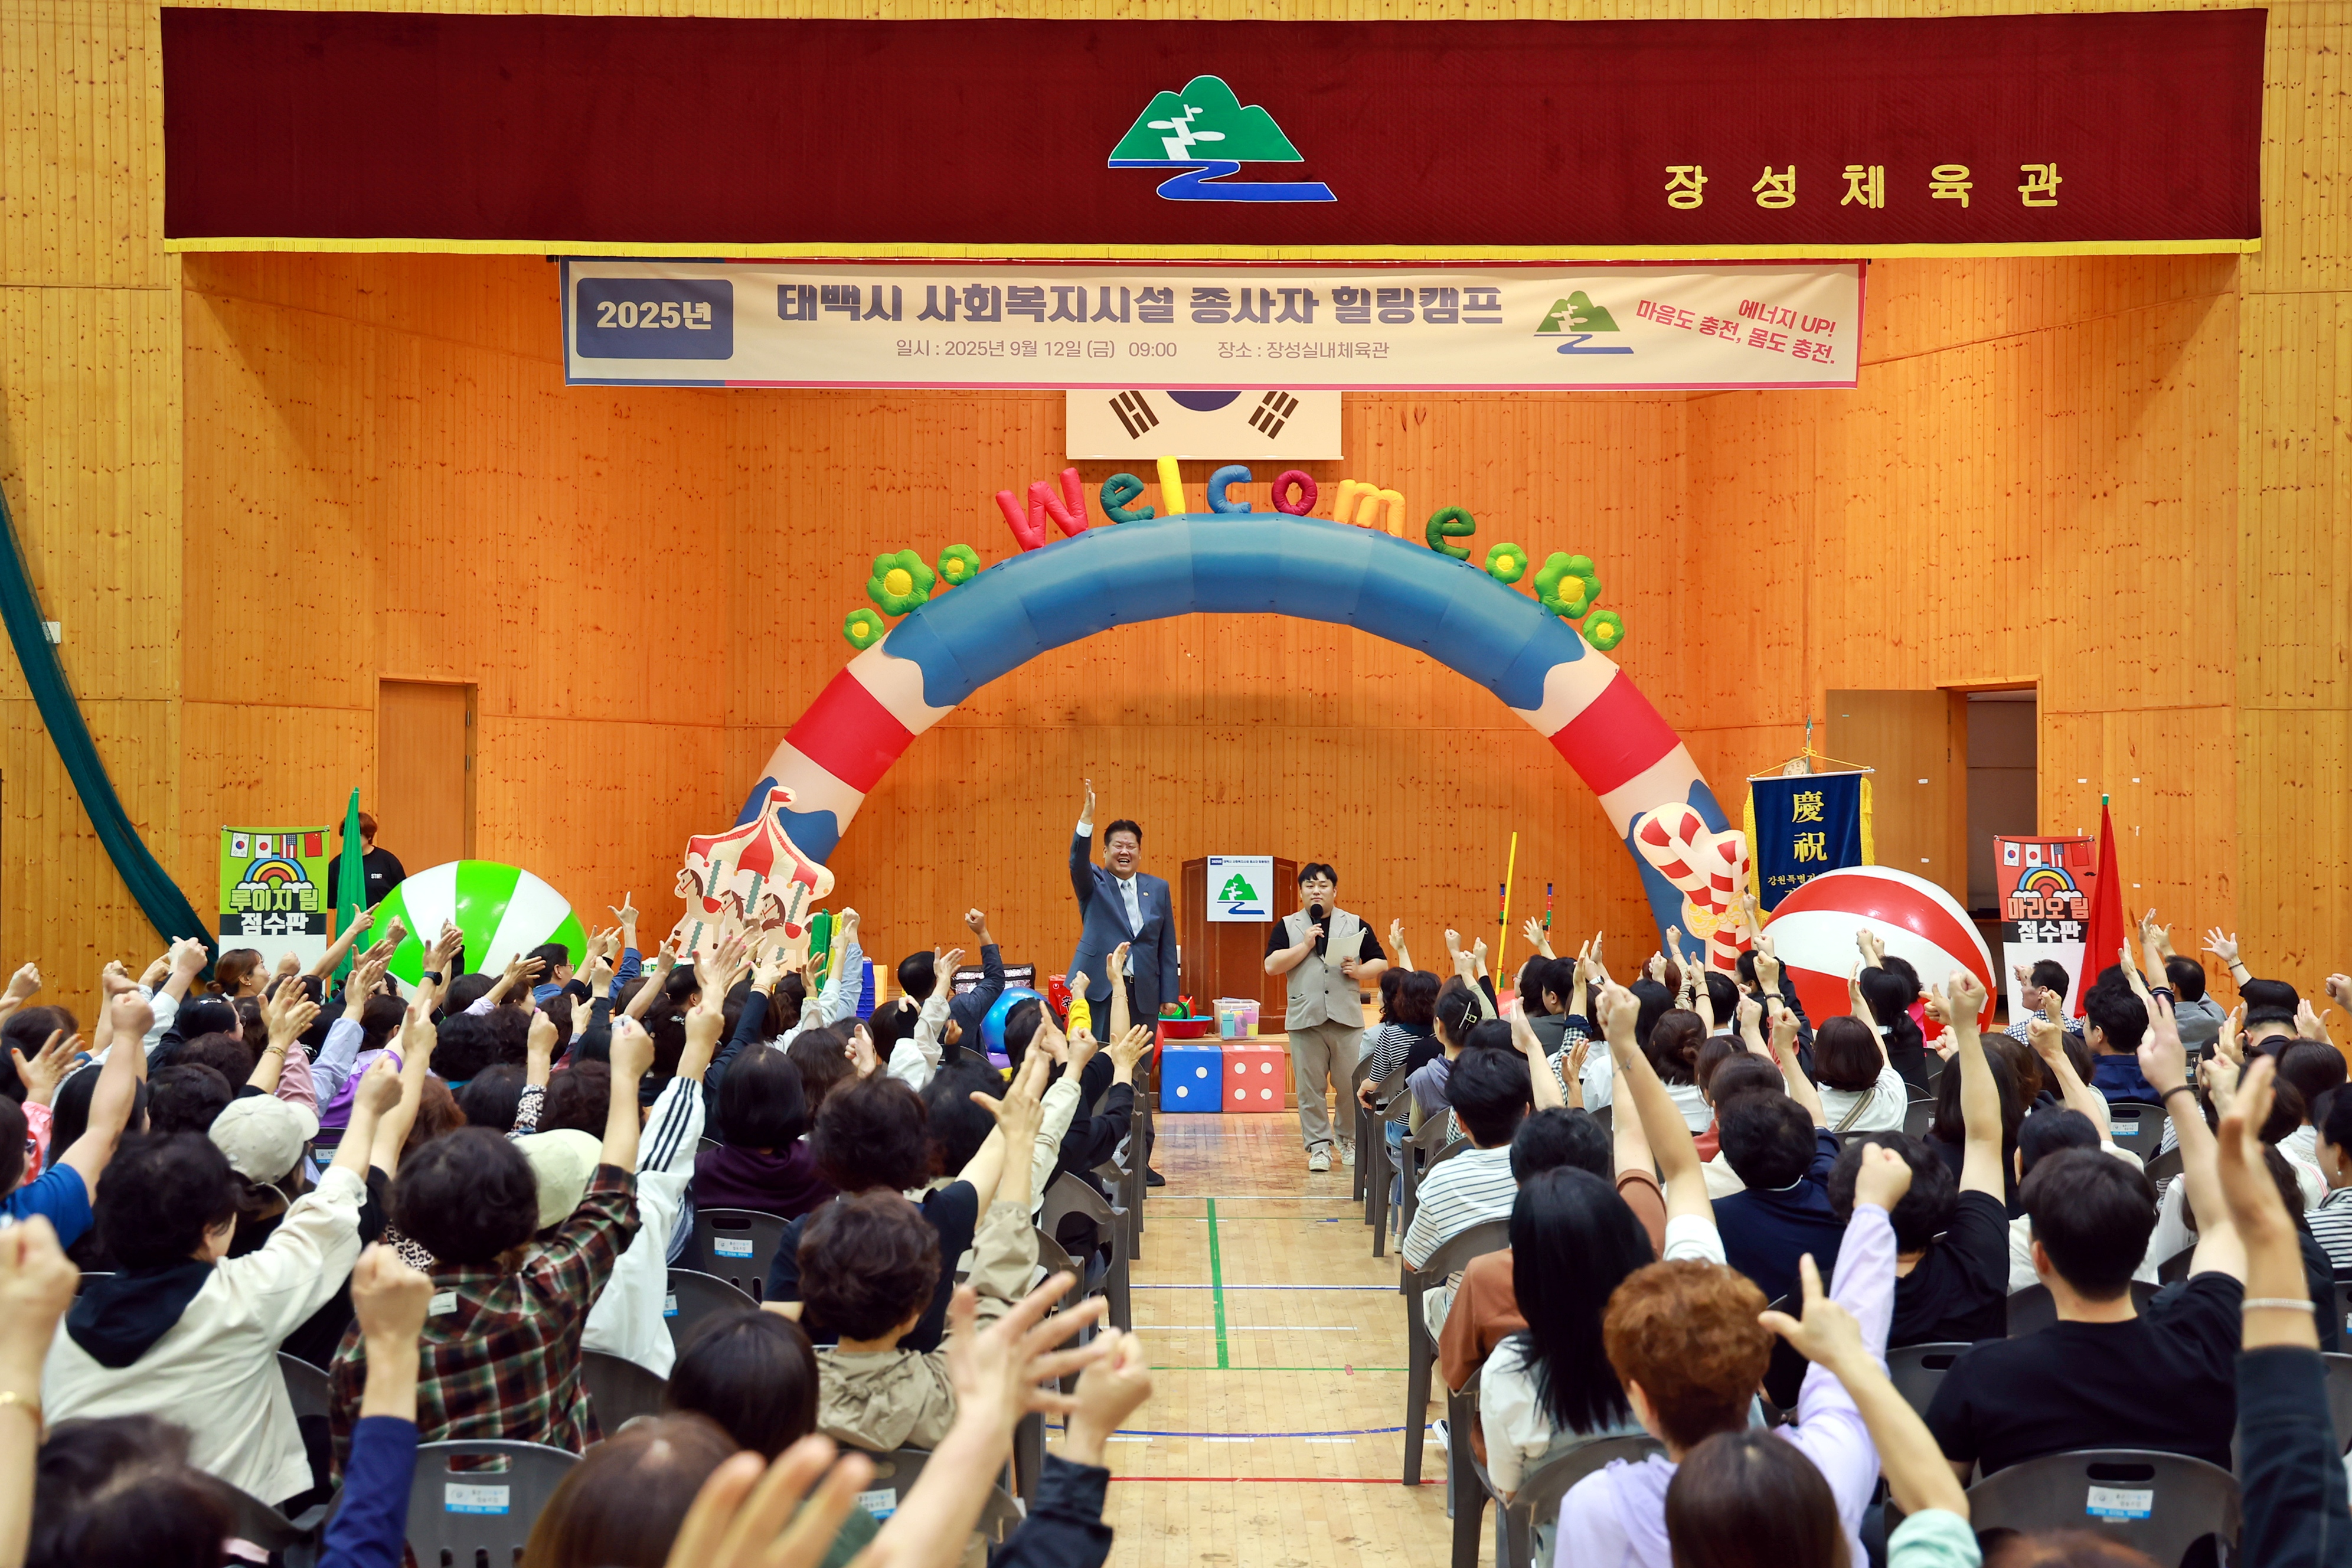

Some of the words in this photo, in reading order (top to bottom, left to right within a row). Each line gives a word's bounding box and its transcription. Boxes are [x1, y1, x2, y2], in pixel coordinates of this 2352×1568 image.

[596, 300, 711, 330] 2025년
[777, 285, 902, 321] 태백시
[916, 283, 1174, 324] 사회복지시설
[1190, 286, 1319, 324] 종사자
[1331, 286, 1503, 324] 힐링캠프
[1738, 299, 1798, 329] 에너지
[1801, 315, 1837, 338] UP!
[1636, 300, 1696, 330] 마음도
[1699, 316, 1741, 344] 충전,
[1747, 327, 1788, 352] 몸도
[1792, 338, 1835, 364] 충전.
[896, 339, 930, 357] 일시
[945, 341, 1005, 357] 2025년
[1010, 341, 1037, 358] 9월
[1044, 341, 1082, 358] 12일
[1087, 341, 1115, 358] (금)
[1129, 342, 1177, 357] 09:00
[1218, 342, 1252, 358] 장소
[1266, 342, 1390, 359] 장성실내체육관
[1791, 790, 1828, 863] 慶祝
[230, 888, 293, 913] 루이지
[299, 888, 319, 913] 팀
[2007, 897, 2066, 920] 마리오
[2069, 897, 2090, 920] 팀
[241, 913, 309, 935] 점수판
[2017, 920, 2082, 943] 점수판
